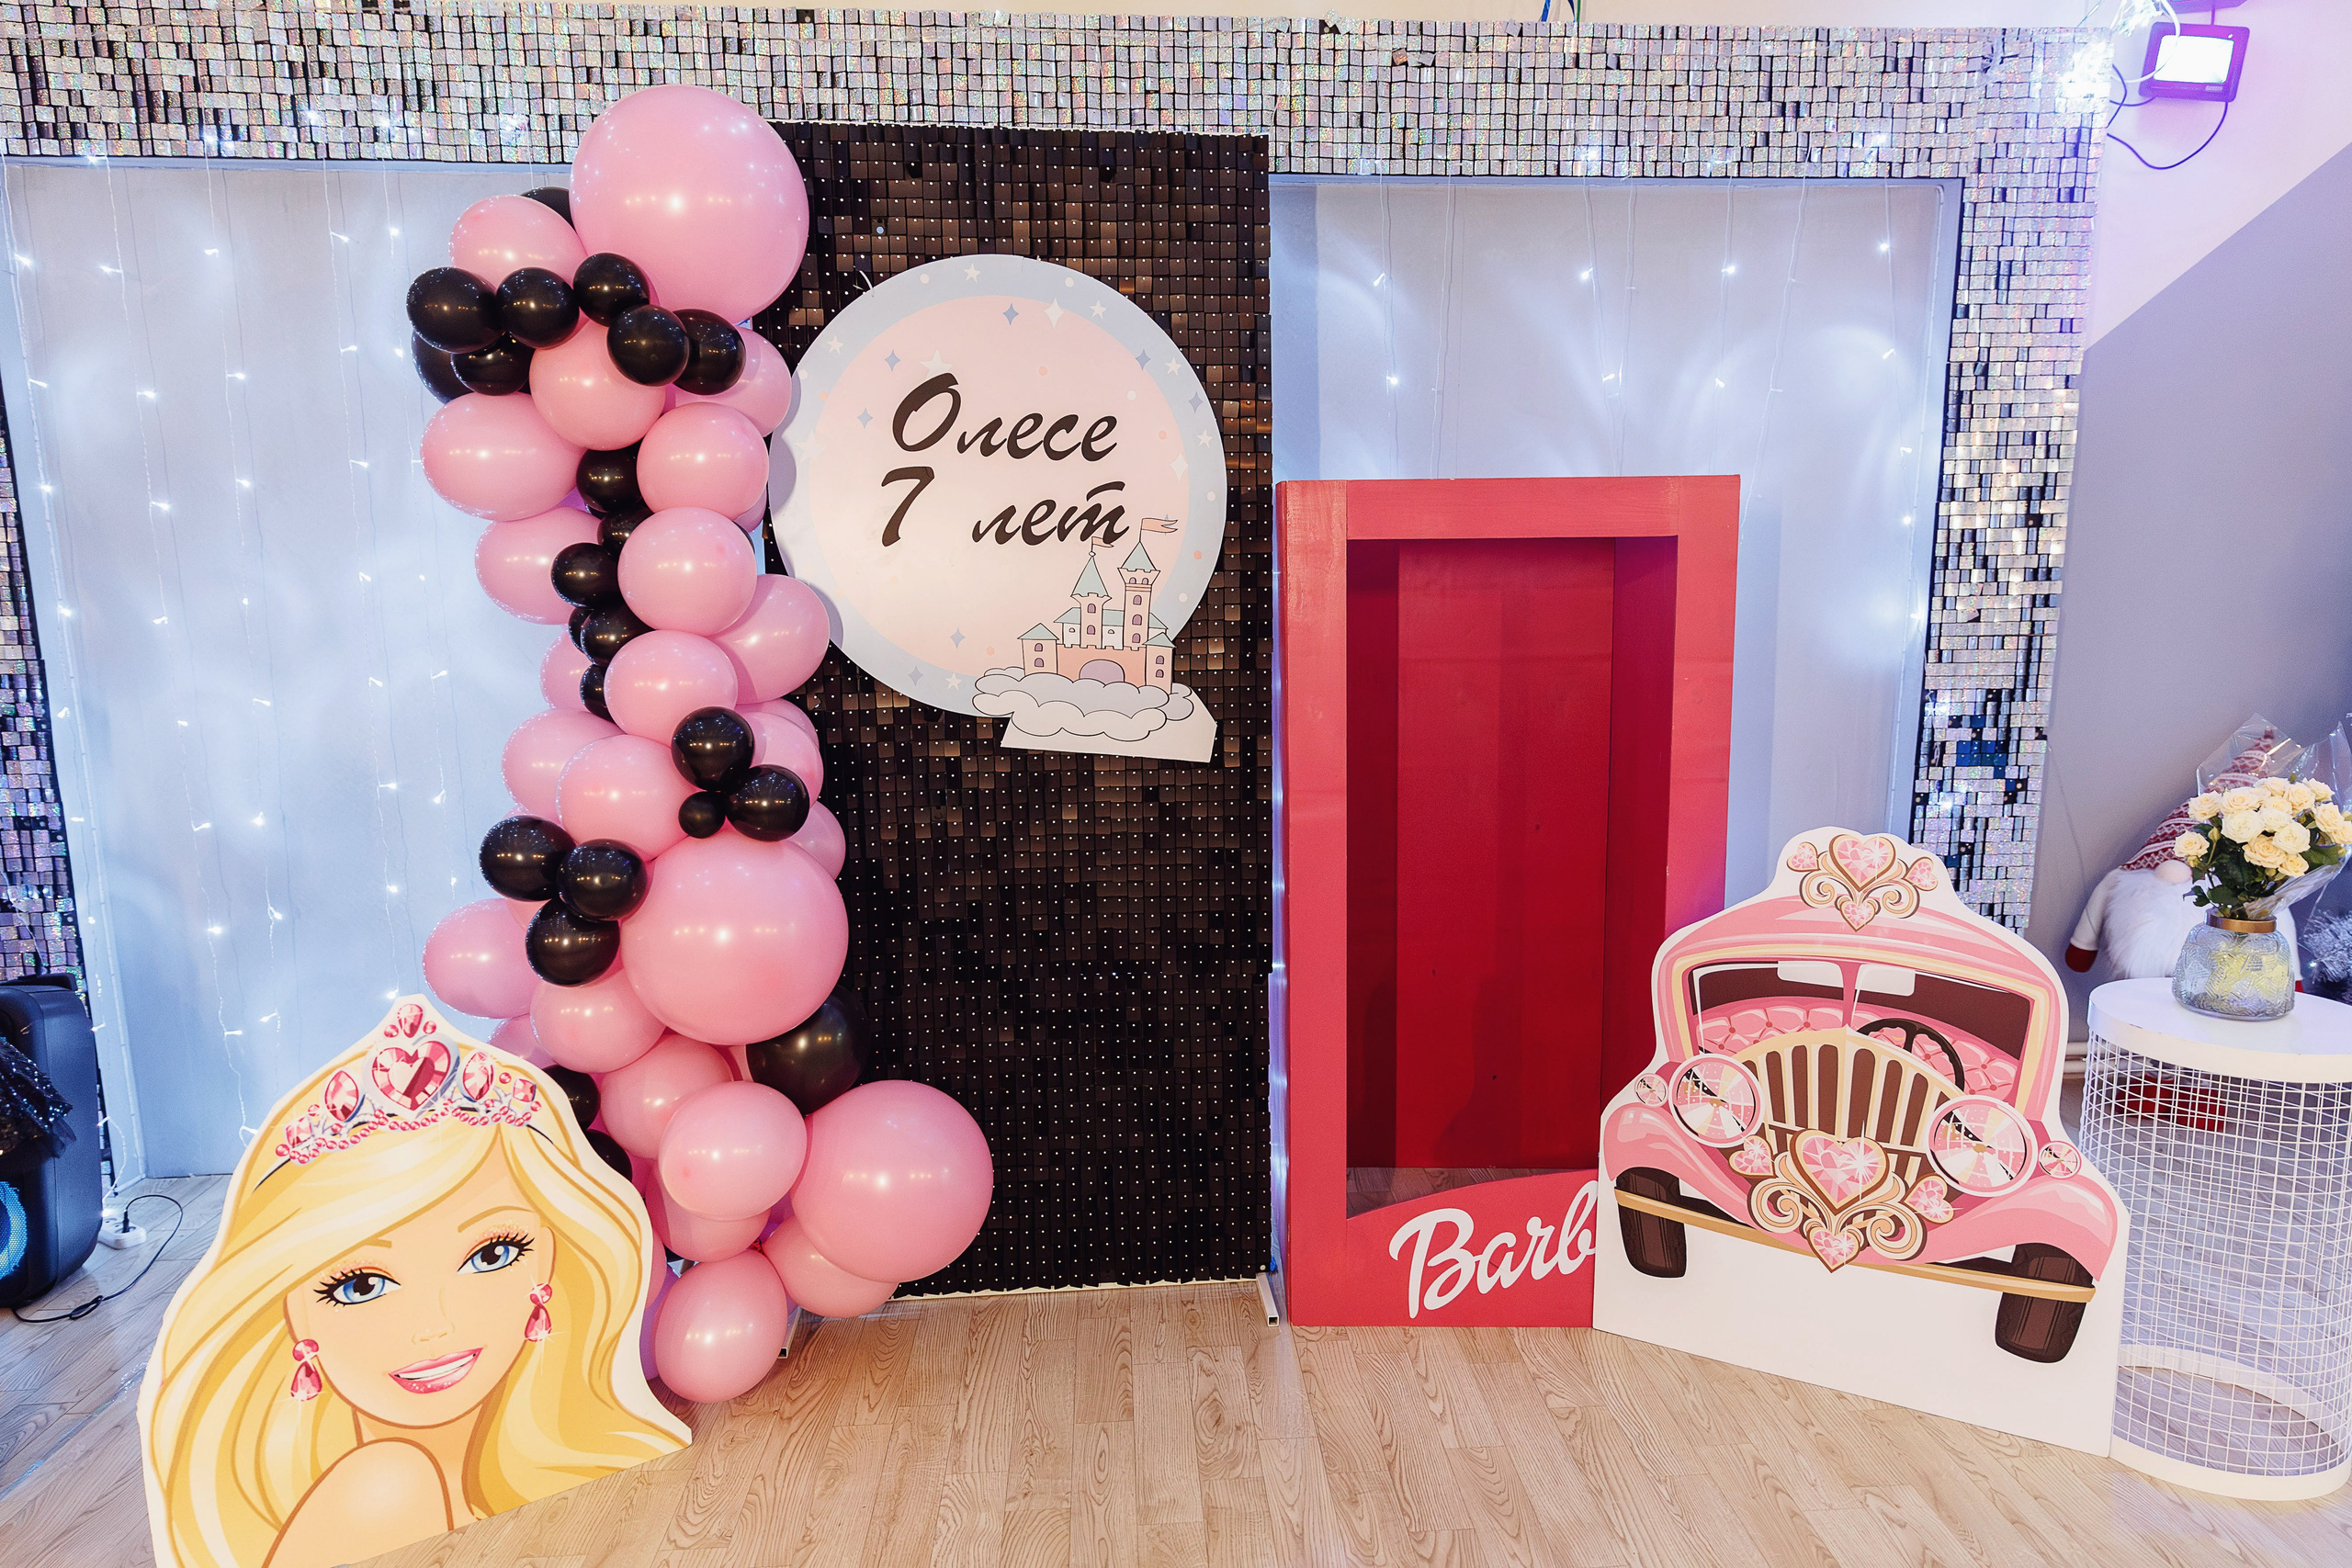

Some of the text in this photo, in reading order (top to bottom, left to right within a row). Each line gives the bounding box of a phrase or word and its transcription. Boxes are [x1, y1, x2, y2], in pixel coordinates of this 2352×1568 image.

[892, 372, 1117, 461] Олесе
[881, 466, 1130, 547] 7 лет
